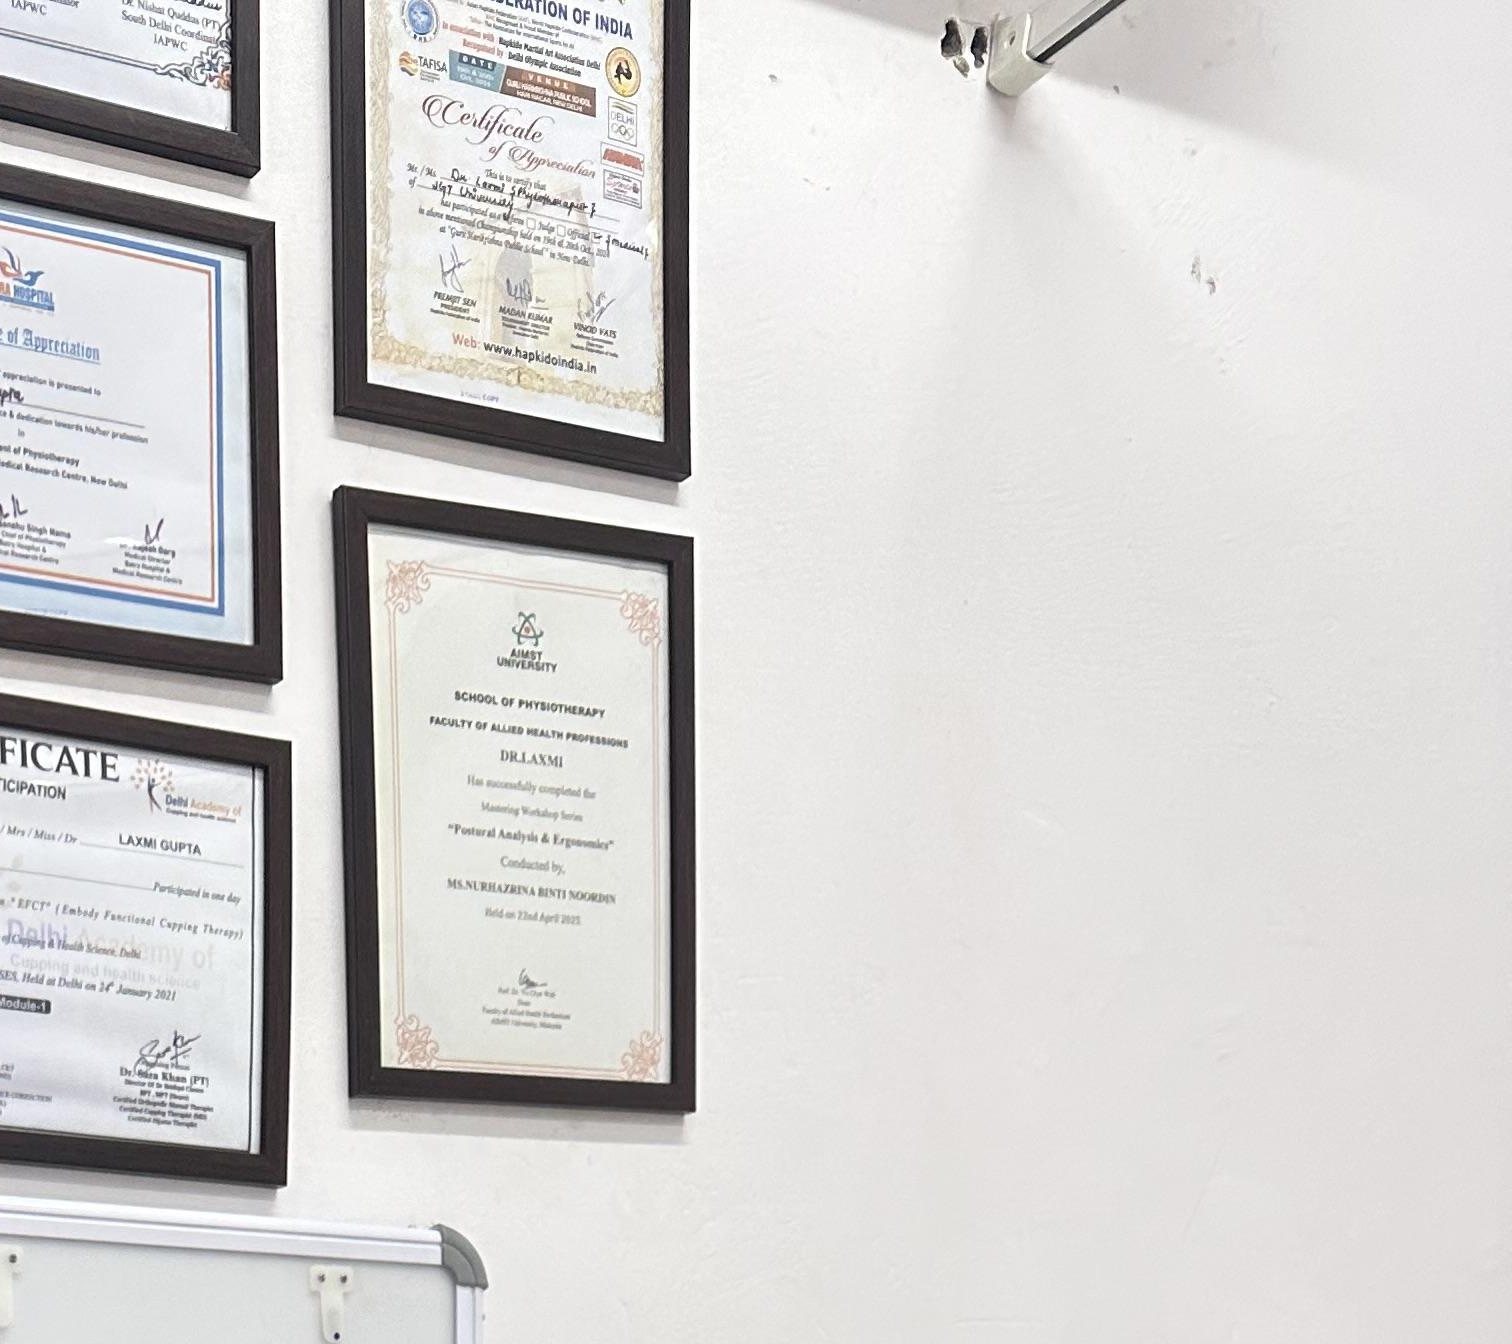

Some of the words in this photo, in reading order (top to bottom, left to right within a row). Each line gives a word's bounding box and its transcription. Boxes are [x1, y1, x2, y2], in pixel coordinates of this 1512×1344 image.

[573, 11, 590, 26] OF
[595, 16, 632, 39] INDIA
[418, 56, 448, 73] TAFISA
[422, 94, 555, 145] Certificate
[13, 284, 55, 305] HOSPITAL
[7, 327, 19, 347] of
[23, 329, 99, 360] Appreciation
[452, 333, 480, 349] Web:
[484, 342, 596, 373] www.hapkidoindia.in
[13, 446, 21, 456] of
[23, 448, 79, 467] Physiotherapy
[497, 657, 557, 672] UNIVERSITY
[510, 648, 542, 663] AIMST
[454, 691, 498, 706] SCHOOL
[501, 697, 515, 707] OF
[518, 699, 605, 718] PHYSIOTHERAPY
[429, 716, 472, 729] FACULTY
[475, 721, 488, 731] OF
[491, 723, 524, 735] ALLIED
[526, 728, 563, 740] HEALTH
[566, 732, 628, 748] PROFESSIONS
[7, 825, 25, 836] Mrs
[34, 829, 55, 840] Miss
[64, 833, 78, 844] Dr
[119, 834, 156, 849] LAXMI
[160, 840, 201, 856] GUPTA
[498, 829, 538, 844] Analysis
[541, 832, 550, 844] &
[500, 856, 549, 871] Conducted
[538, 887, 566, 899] BINTI
[569, 891, 615, 904] NOORDIN
[104, 910, 155, 926] Functional
[160, 918, 198, 934] Cupping
[203, 924, 243, 940] Therapy)
[22, 972, 45, 985] Held
[46, 977, 56, 986] at
[58, 977, 83, 989] Delhi
[85, 983, 96, 992] on
[116, 984, 152, 1000] January
[154, 989, 176, 1001] 2021
